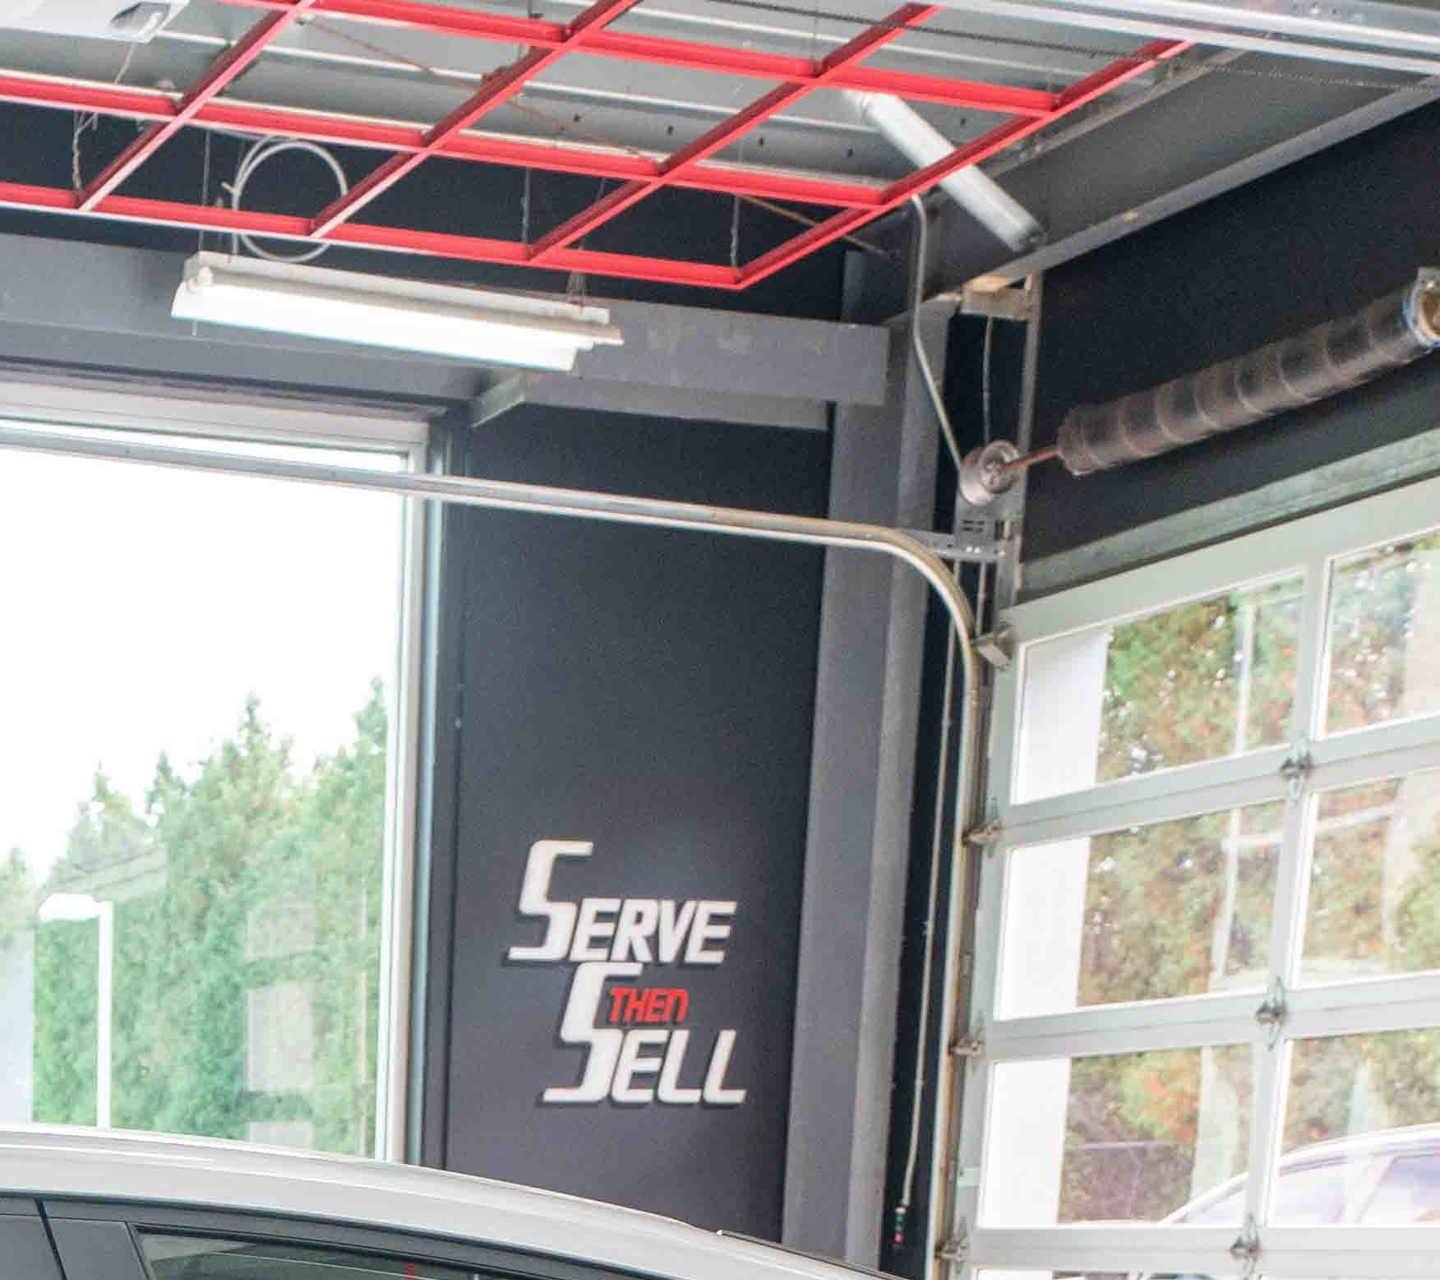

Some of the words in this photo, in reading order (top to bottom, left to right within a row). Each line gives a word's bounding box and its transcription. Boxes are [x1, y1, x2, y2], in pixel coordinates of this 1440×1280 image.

[508, 839, 737, 964] SERVE
[543, 963, 747, 1103] SELL
[608, 988, 690, 1024] THEN
